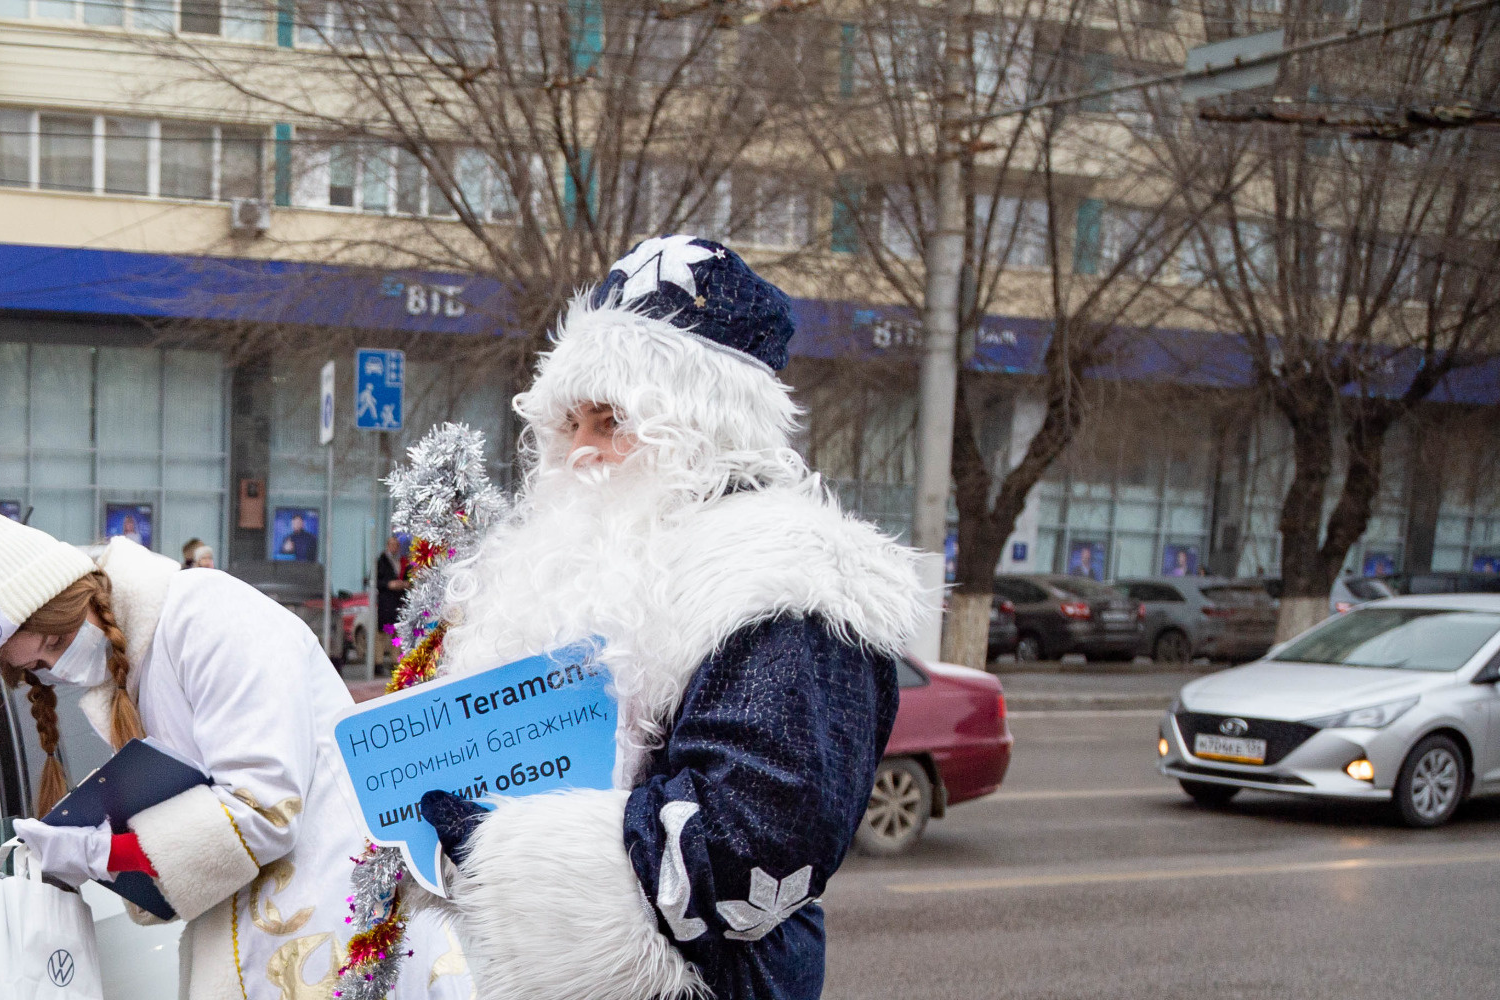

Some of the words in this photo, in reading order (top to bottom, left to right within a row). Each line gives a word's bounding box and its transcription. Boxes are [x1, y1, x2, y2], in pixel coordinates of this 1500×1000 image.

[349, 697, 452, 757] НОВЫЙ
[366, 738, 480, 792] огромный
[486, 701, 608, 753] багажник,
[378, 774, 489, 828] ширий
[495, 754, 572, 791] обзор
